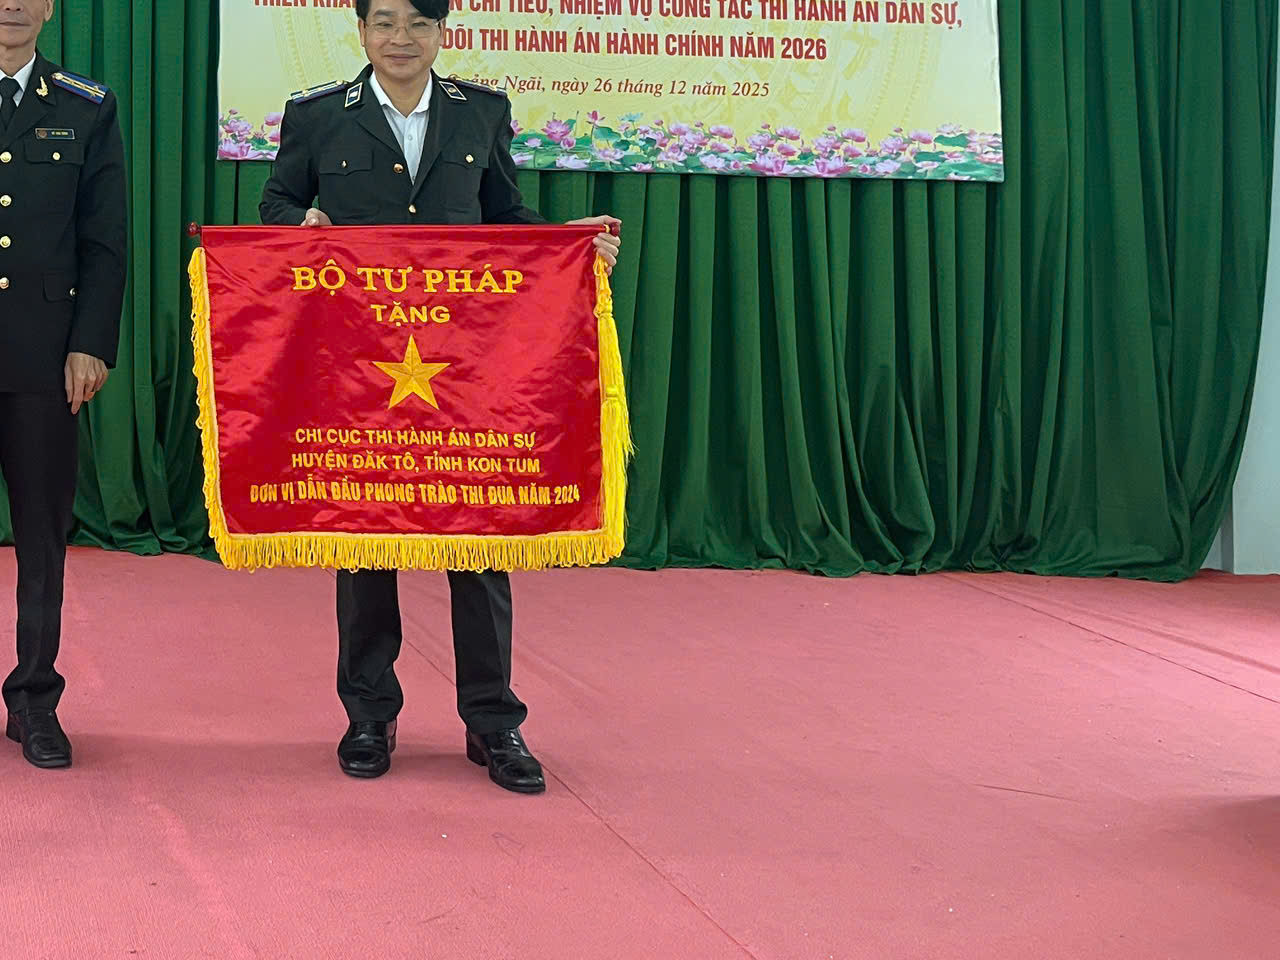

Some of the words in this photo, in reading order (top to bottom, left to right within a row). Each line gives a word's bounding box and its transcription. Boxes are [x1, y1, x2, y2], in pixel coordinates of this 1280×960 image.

[931, 1, 962, 30] SỰ,
[479, 29, 508, 51] THI
[515, 26, 566, 53] HÀNH
[574, 27, 600, 54] ÁN
[606, 28, 658, 55] HÀNH
[665, 30, 723, 57] CHÍNH
[730, 32, 774, 59] NĂM
[781, 38, 827, 60] 2026
[505, 75, 545, 93] Ngãi,
[551, 79, 588, 96] ngày
[593, 79, 613, 93] 26
[618, 78, 662, 97] tháng
[669, 81, 687, 95] 12
[692, 81, 726, 96] năm
[732, 82, 769, 97] 2025
[291, 259, 346, 296] BỘ
[356, 266, 413, 293] TƯ
[422, 264, 523, 293] PHÁP
[370, 301, 451, 327] TẶNG
[295, 428, 322, 443] CHI
[326, 429, 361, 447] CỤC
[365, 430, 393, 444] THI
[397, 426, 443, 446] HÀNH
[448, 428, 470, 447] ÁN
[474, 429, 509, 448] DÂN
[513, 432, 536, 451] SỰ
[292, 449, 347, 470] HUYỆN
[352, 450, 389, 470] ĐĂK
[392, 451, 419, 473] TÔ,
[424, 450, 463, 471] TỈNH
[467, 457, 502, 473] KON
[506, 458, 540, 473] TUM
[281, 482, 294, 504] VỊ
[297, 473, 327, 500] DẪN
[365, 482, 415, 503] PHONG
[418, 480, 457, 504] TRÀO
[460, 484, 485, 505] THI
[487, 485, 516, 505] ĐUA
[519, 482, 551, 505] NĂM
[554, 484, 580, 505] 2024
